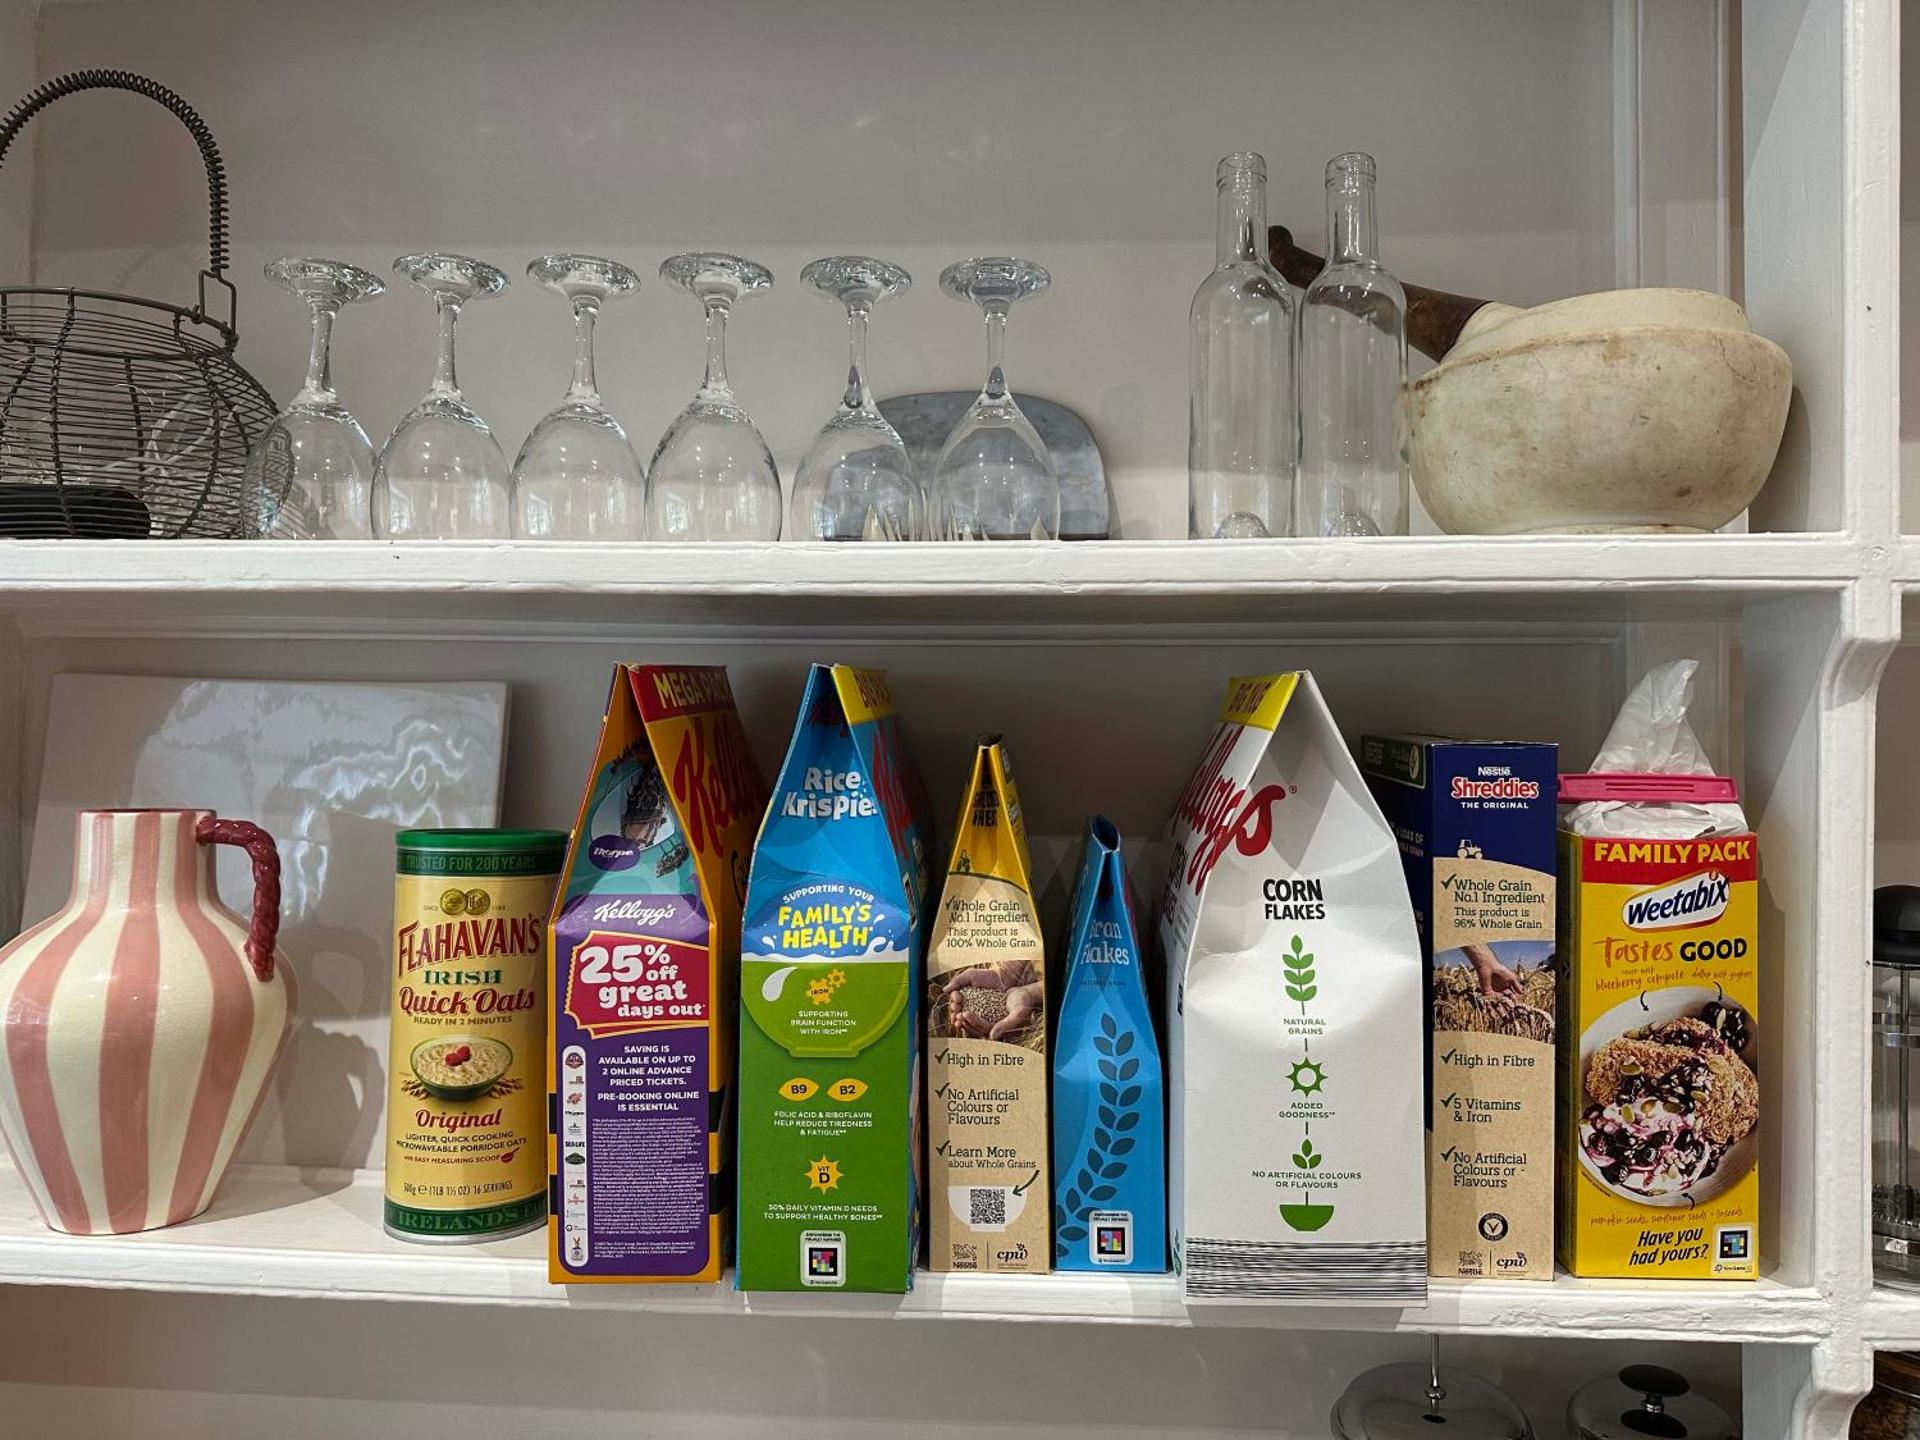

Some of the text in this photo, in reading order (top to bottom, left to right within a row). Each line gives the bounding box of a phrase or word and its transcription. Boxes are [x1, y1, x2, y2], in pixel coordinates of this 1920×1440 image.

[652, 672, 696, 709] MEGA
[804, 768, 860, 792] Rice
[1451, 776, 1540, 799] Shreddies
[1594, 841, 1750, 864] FAMILY PACK
[407, 855, 536, 871] TRUSTED FOR 200 YEARS
[1262, 879, 1323, 901] CORN
[1454, 880, 1532, 891] Whole Grain
[783, 886, 875, 903] SUPPORTING YOUR
[1454, 893, 1545, 905] No.1 Ingredient
[1628, 870, 1730, 924] Weetabix
[952, 900, 1020, 912] Whole Grain
[1265, 903, 1326, 920] FLAKES
[593, 900, 676, 926] Kellogg's
[778, 902, 872, 929] FAMILY'S
[1454, 907, 1529, 919] This product is
[1480, 920, 1512, 928] Whole
[948, 927, 1018, 938] This product is
[398, 914, 540, 980] FLAHAVAN'S
[946, 938, 1036, 948] 100% Whole Grain
[1592, 937, 1747, 968] Tastes GOOD
[424, 970, 502, 985] IRISH
[646, 964, 678, 981] off
[1595, 978, 1641, 991] blueberry
[599, 980, 687, 1008] great
[400, 986, 534, 1015] Quick Oats
[618, 1002, 664, 1019] days
[414, 1016, 513, 1025] READY IN 2 MINUTES
[1283, 1018, 1326, 1026] NATURAL
[1288, 1027, 1323, 1035] GRAINS
[624, 1046, 658, 1054] SAVING
[598, 1056, 649, 1064] AVAILABLE
[652, 1056, 666, 1064] ON
[947, 1053, 1024, 1068] High in Fibre
[1454, 1054, 1535, 1068] High in Fibre
[610, 1067, 645, 1075] ONLINE
[648, 1066, 692, 1074] ADVANCE
[610, 1077, 687, 1086] PRICED TICKETS.
[791, 1085, 855, 1094] B9 B2
[948, 1089, 1019, 1100] No Artificial
[598, 1091, 699, 1101] PRE-BOOKING ONLINE
[629, 1103, 678, 1111] ESSENTIAL
[947, 1101, 1009, 1113] Colours or
[1454, 1098, 1521, 1110] 5 Vitamins
[415, 1109, 502, 1133] Original
[948, 1113, 1001, 1125] Flavours
[1454, 1111, 1492, 1123] & Iron
[472, 1131, 513, 1142] COOKING
[461, 1141, 505, 1152] PORRIDGE
[949, 1147, 1016, 1158] Learn More
[948, 1160, 1036, 1168] about Whole Grains
[1454, 1152, 1527, 1164] No Artificial
[1268, 1171, 1317, 1179] ARTIFICIAL
[1453, 1164, 1516, 1176] Colours or
[819, 1172, 830, 1183] D
[1454, 1175, 1508, 1189] Flavours
[1291, 1181, 1338, 1189] FLAVOURS
[1638, 1228, 1704, 1246] Have you
[1629, 1244, 1709, 1265] had yours?
